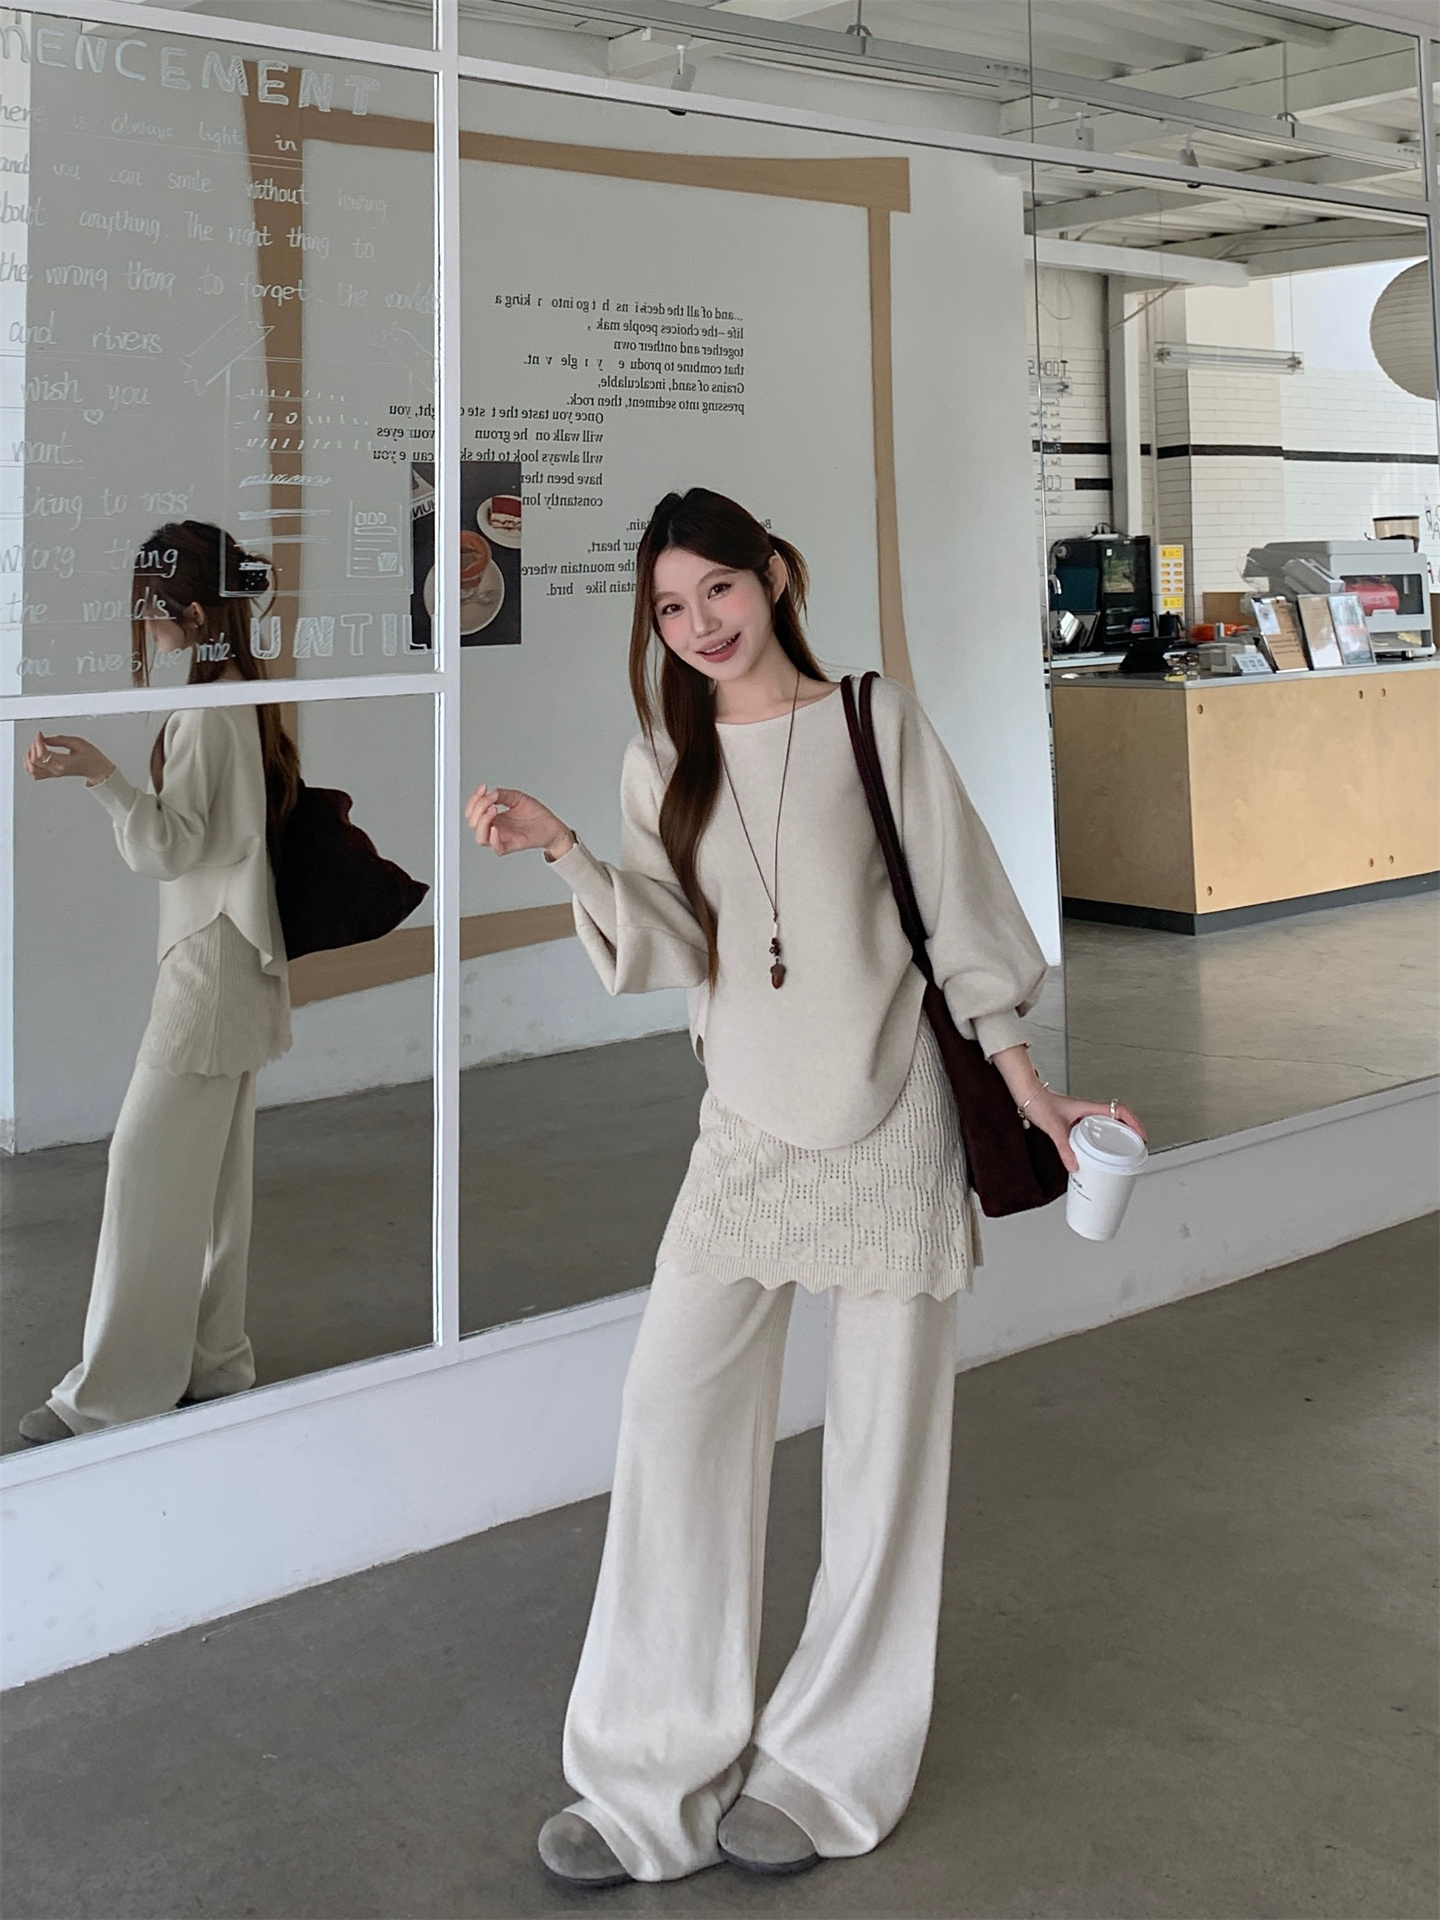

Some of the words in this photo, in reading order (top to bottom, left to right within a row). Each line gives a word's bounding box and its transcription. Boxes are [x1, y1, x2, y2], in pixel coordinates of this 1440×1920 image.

[110, 112, 174, 140] always
[198, 121, 245, 153] light
[273, 133, 298, 152] in
[108, 167, 143, 186] can
[244, 177, 310, 206] without
[228, 220, 273, 247] right
[286, 225, 331, 259] thing
[352, 236, 375, 259] to
[0, 250, 34, 283] the
[45, 263, 108, 292] wrong
[121, 260, 177, 298] thing
[197, 263, 224, 295] to
[9, 310, 57, 345] and
[91, 325, 163, 354] rivers
[20, 371, 83, 404] wish
[107, 384, 152, 411] you
[101, 487, 128, 516] to
